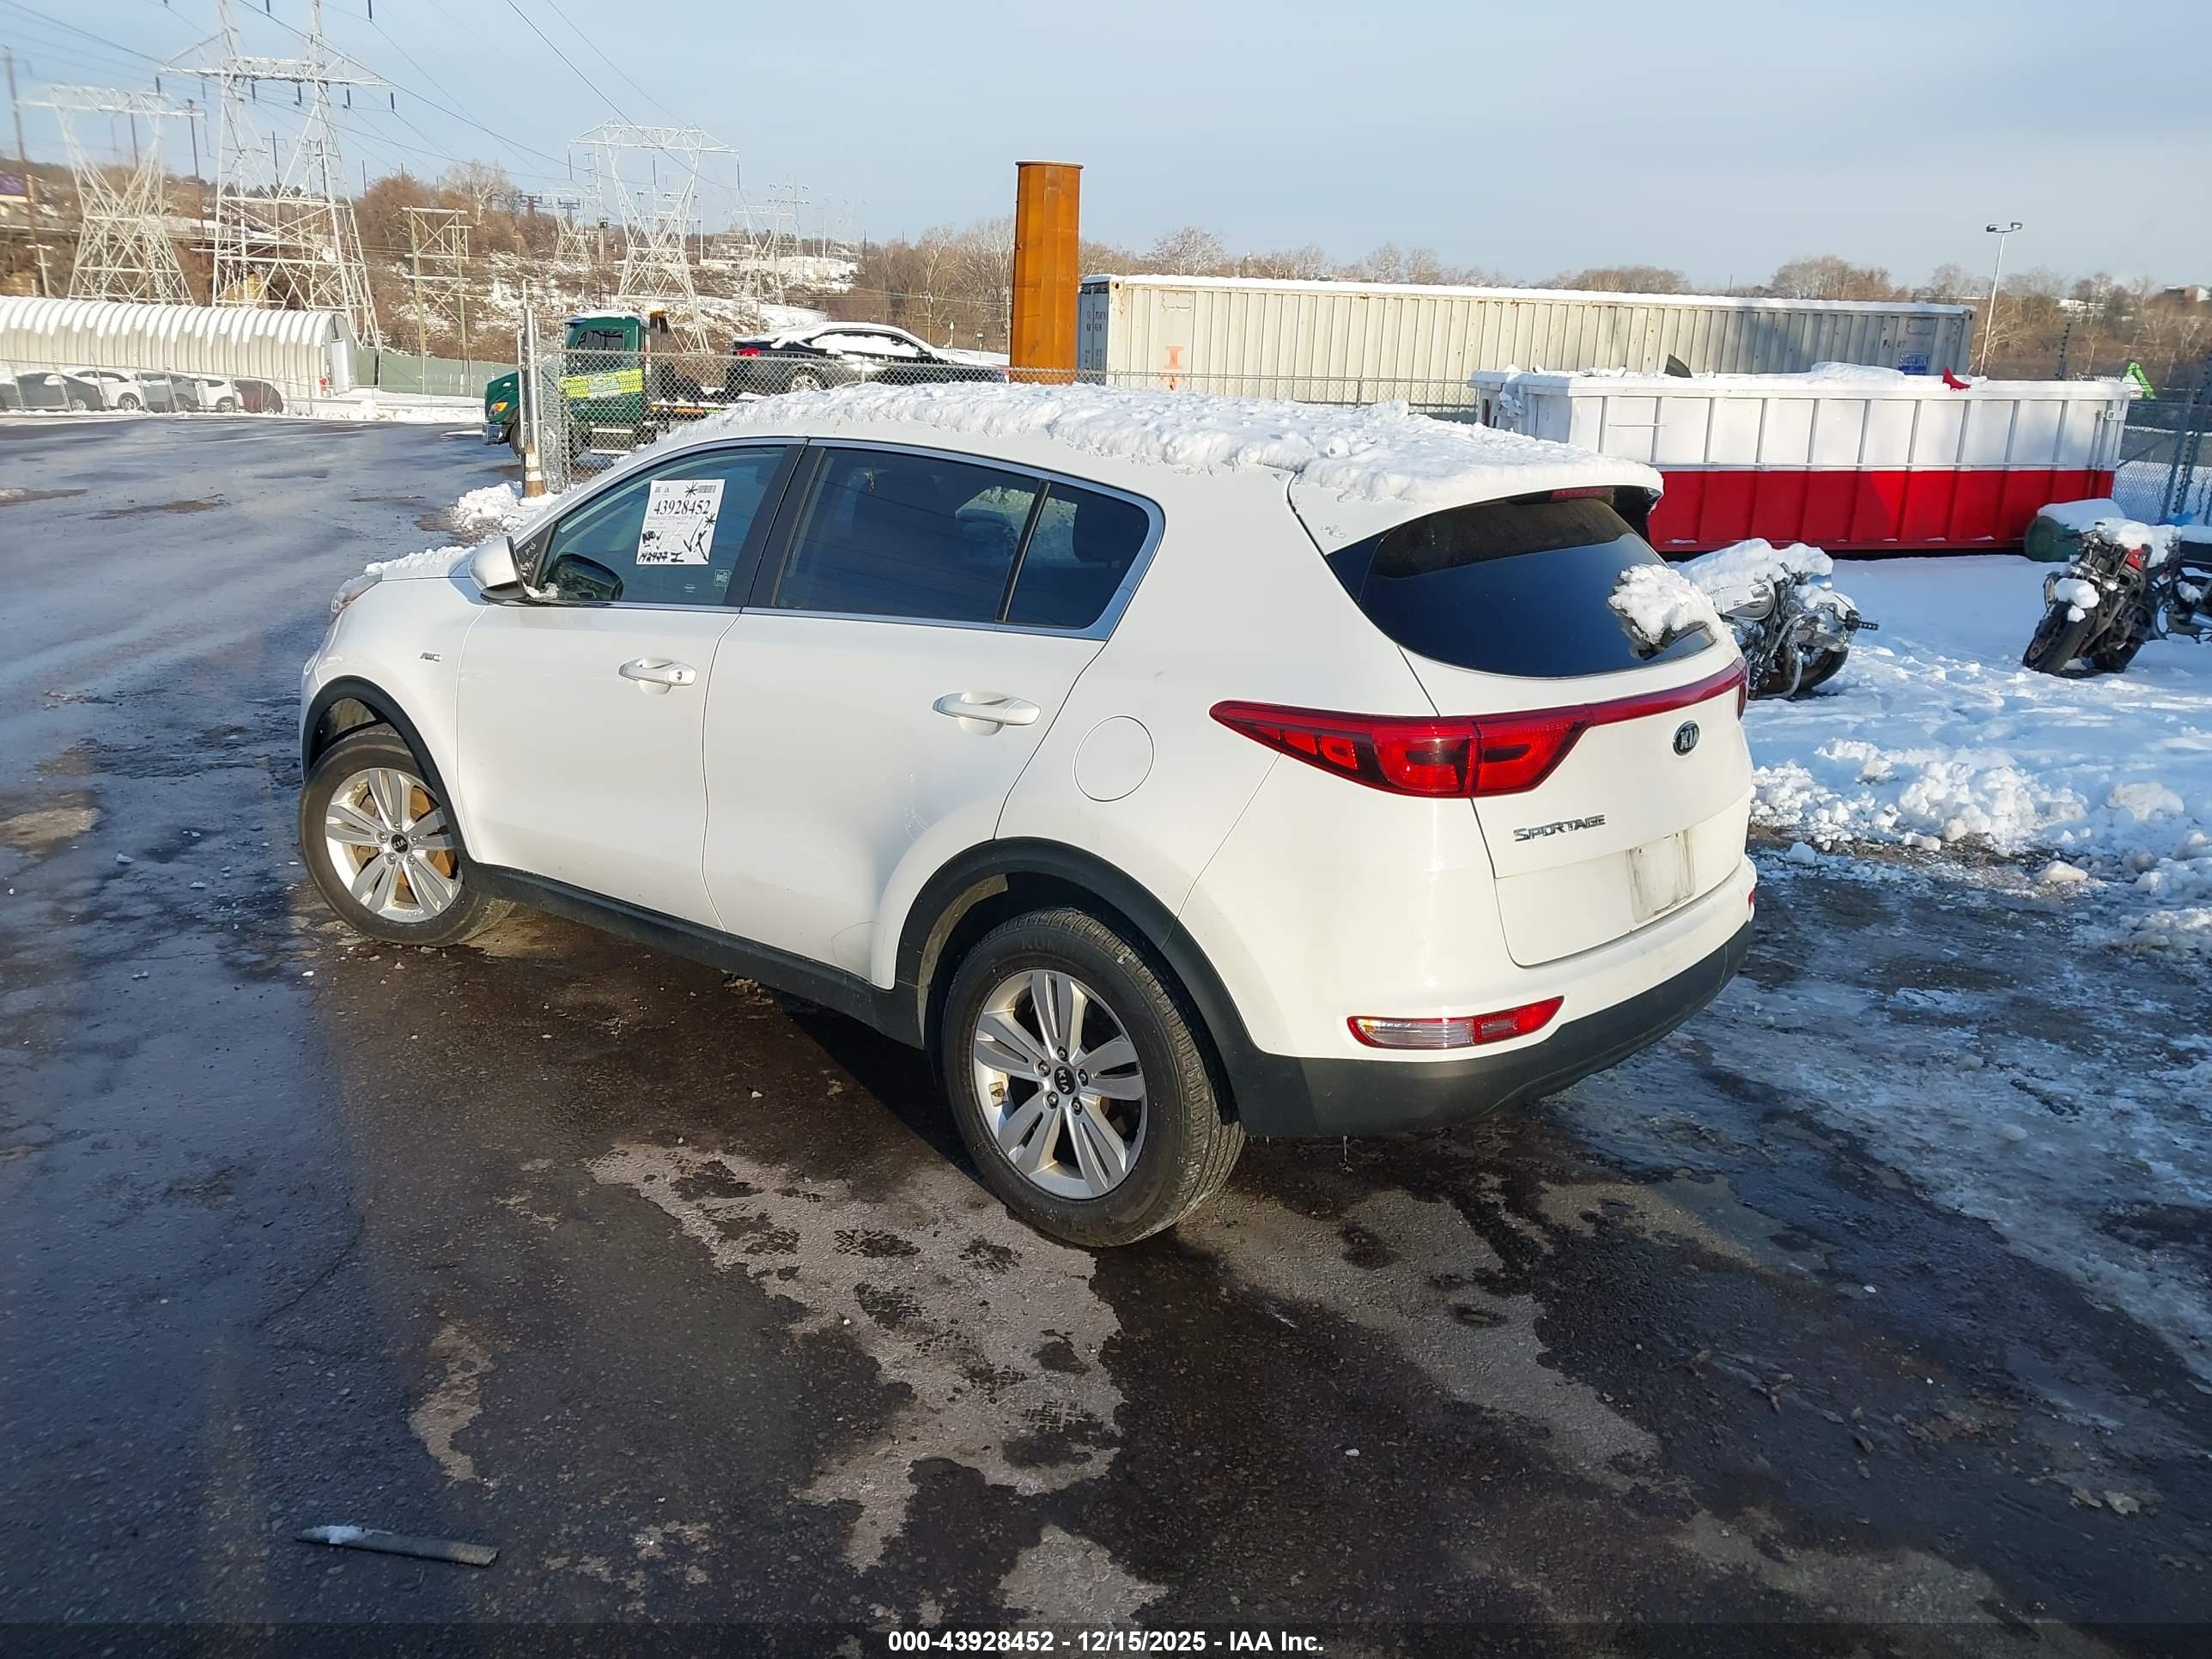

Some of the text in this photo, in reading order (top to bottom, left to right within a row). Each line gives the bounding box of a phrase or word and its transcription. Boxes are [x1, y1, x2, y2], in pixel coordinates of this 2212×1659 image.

[653, 500, 711, 515] 43928452
[1679, 727, 1699, 750] KIA
[1513, 814, 1607, 842] SPORTAGE
[1057, 1069, 1070, 1093] KIA
